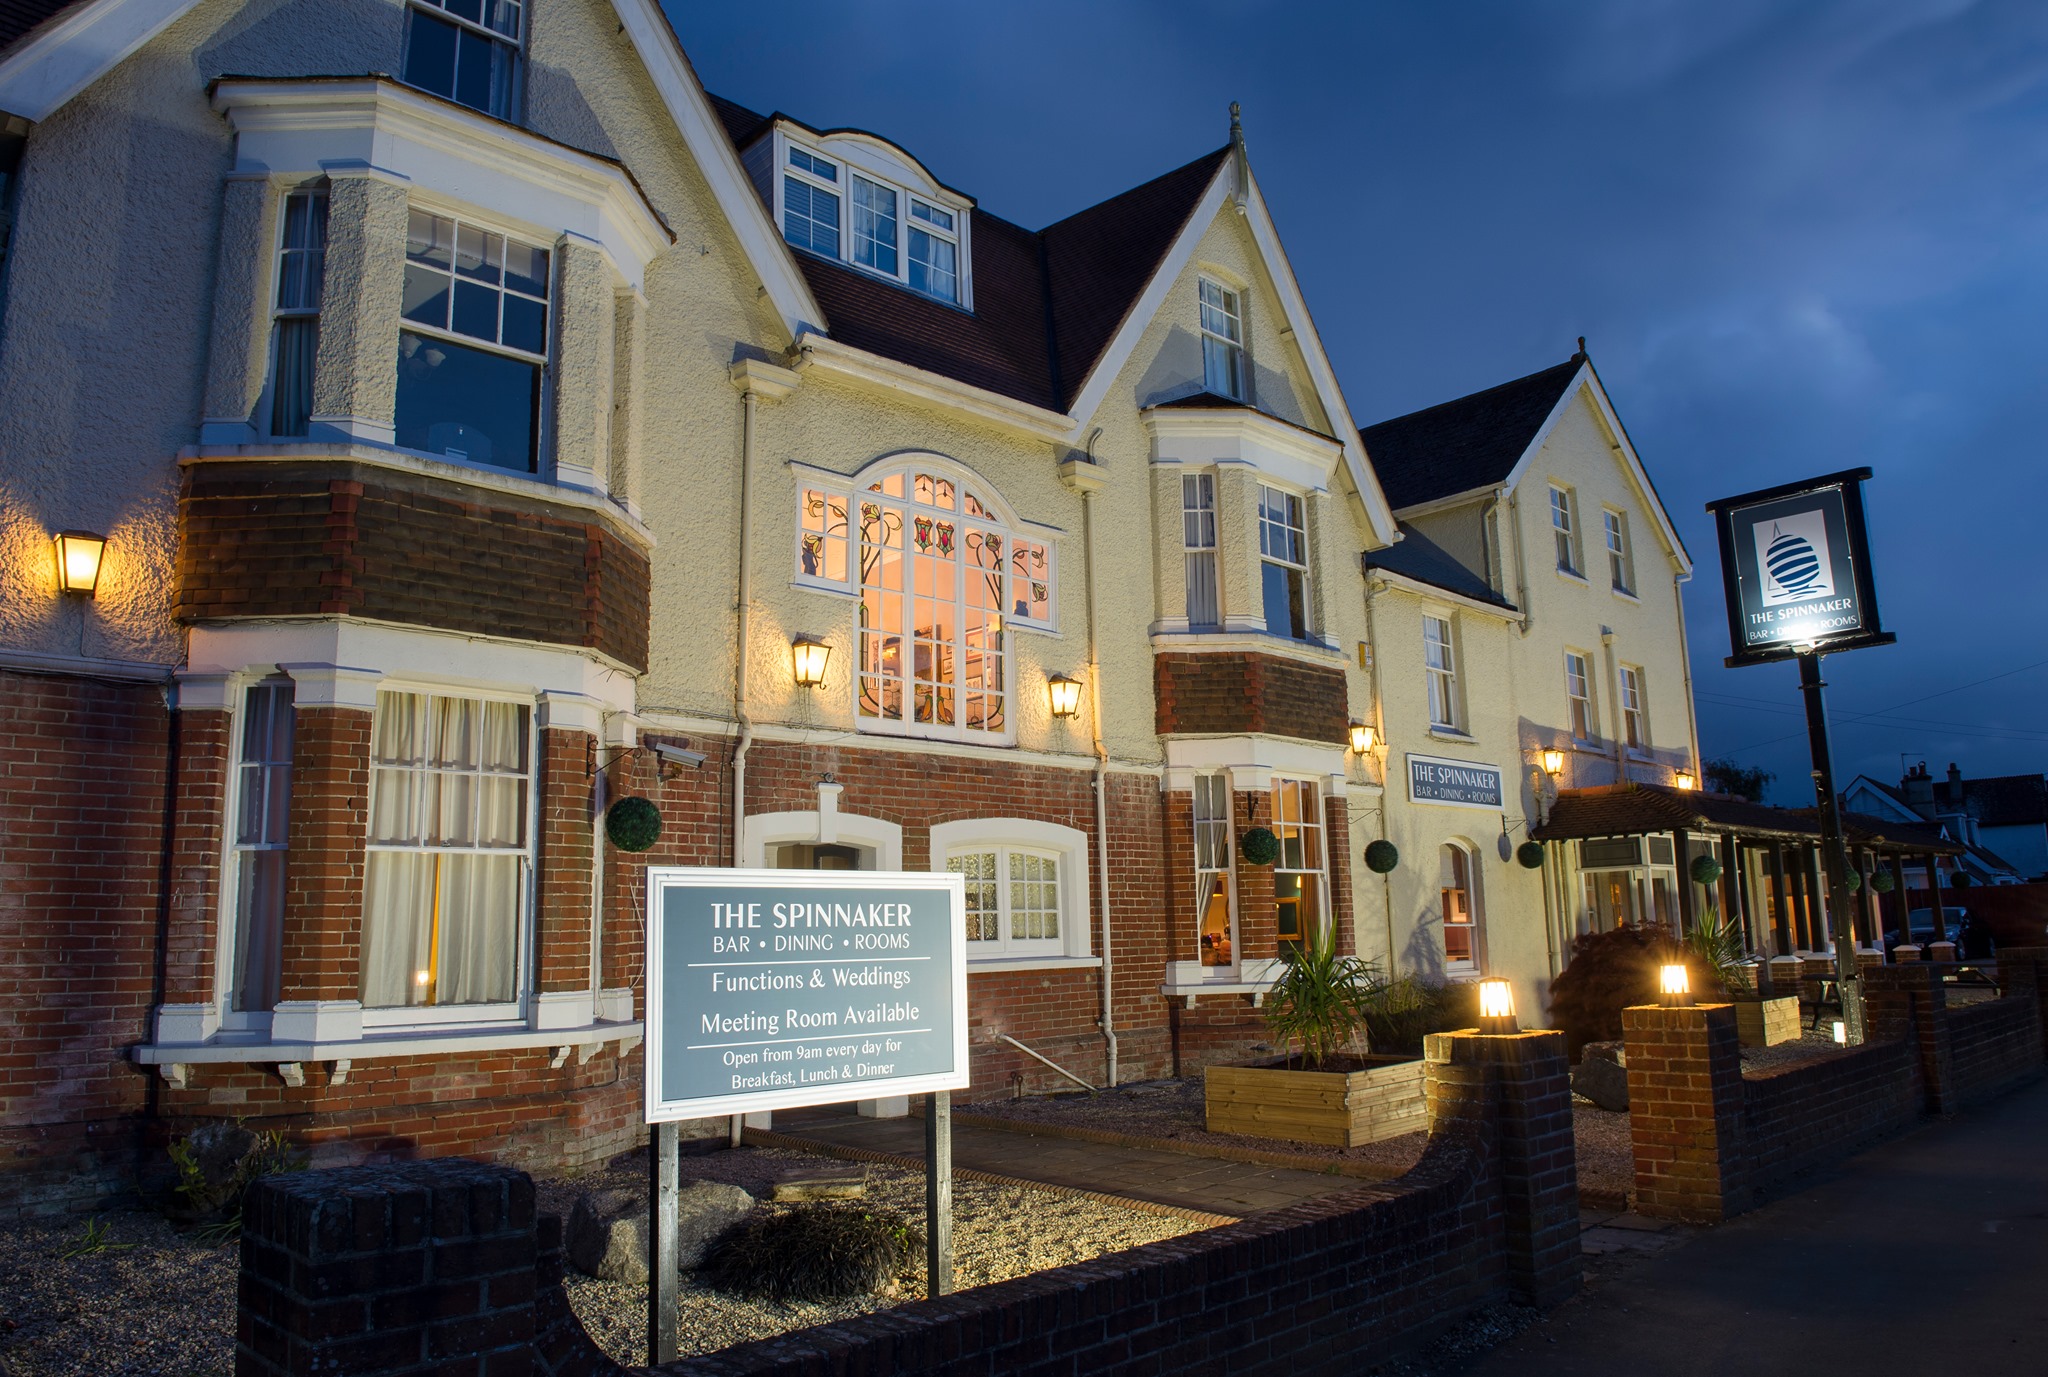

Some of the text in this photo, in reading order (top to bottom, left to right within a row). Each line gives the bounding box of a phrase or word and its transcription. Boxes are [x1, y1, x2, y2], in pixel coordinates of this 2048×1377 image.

[1750, 598, 1852, 624] THE SPINNAKER
[1749, 629, 1768, 640] BAR
[1820, 615, 1857, 629] ROOMS
[1413, 764, 1495, 789] THE SPINNAKER
[1416, 785, 1496, 804] BAR DINING ROOMS
[711, 902, 912, 929] THE SPINNAKER
[713, 932, 910, 953] BAR DINING ROOMS
[713, 966, 911, 992] Functions & Weddings
[701, 1001, 920, 1035] Meeting Room Available
[723, 1038, 902, 1068] Open from 9am every day for
[731, 1062, 895, 1090] Breakfast, Lunch & Dinner
